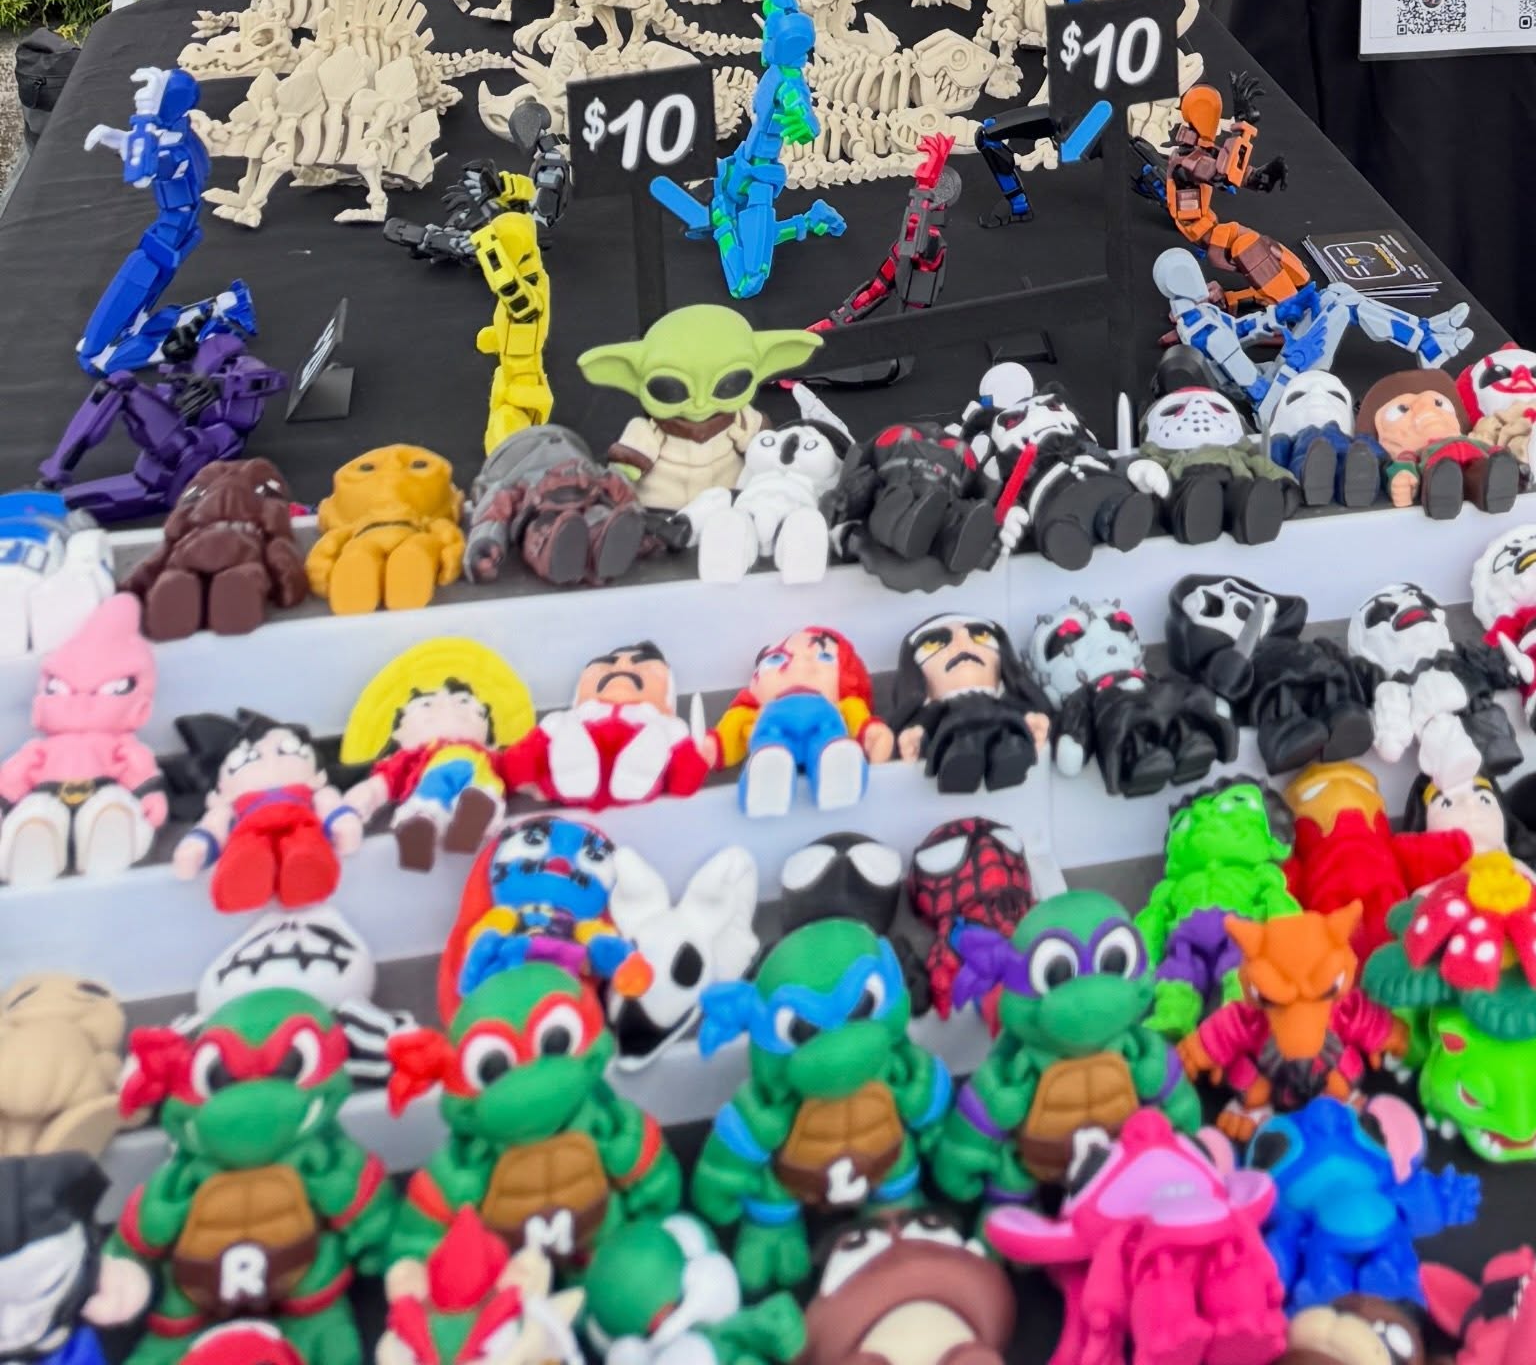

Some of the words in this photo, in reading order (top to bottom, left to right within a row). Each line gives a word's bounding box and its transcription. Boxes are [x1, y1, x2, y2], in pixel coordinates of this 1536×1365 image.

[1059, 17, 1161, 90] $10
[583, 92, 695, 171] $10
[219, 1242, 268, 1302] R
